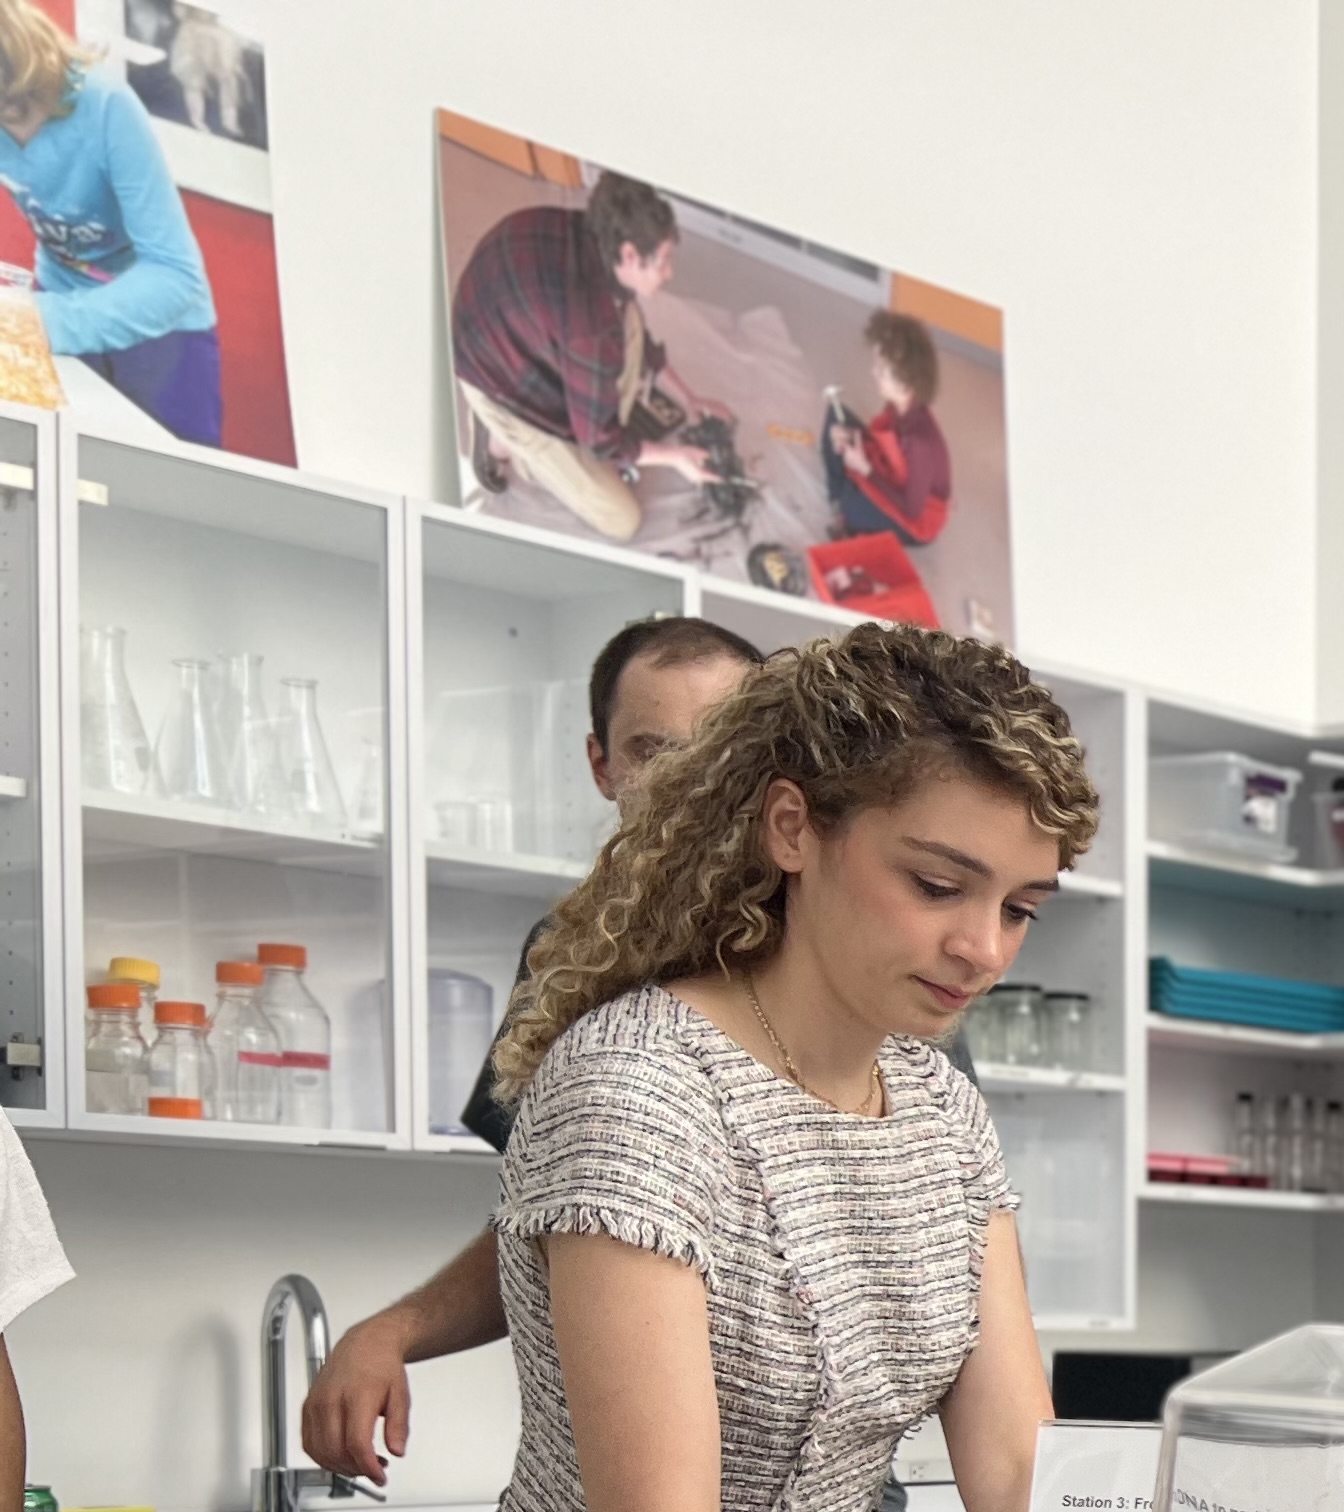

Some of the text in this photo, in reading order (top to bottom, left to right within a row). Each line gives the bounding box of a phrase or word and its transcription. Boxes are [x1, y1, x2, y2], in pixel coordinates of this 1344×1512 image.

[1061, 1495, 1112, 1509] Station
[1116, 1497, 1130, 1510] 3:
[1176, 1489, 1210, 1512] DNA
